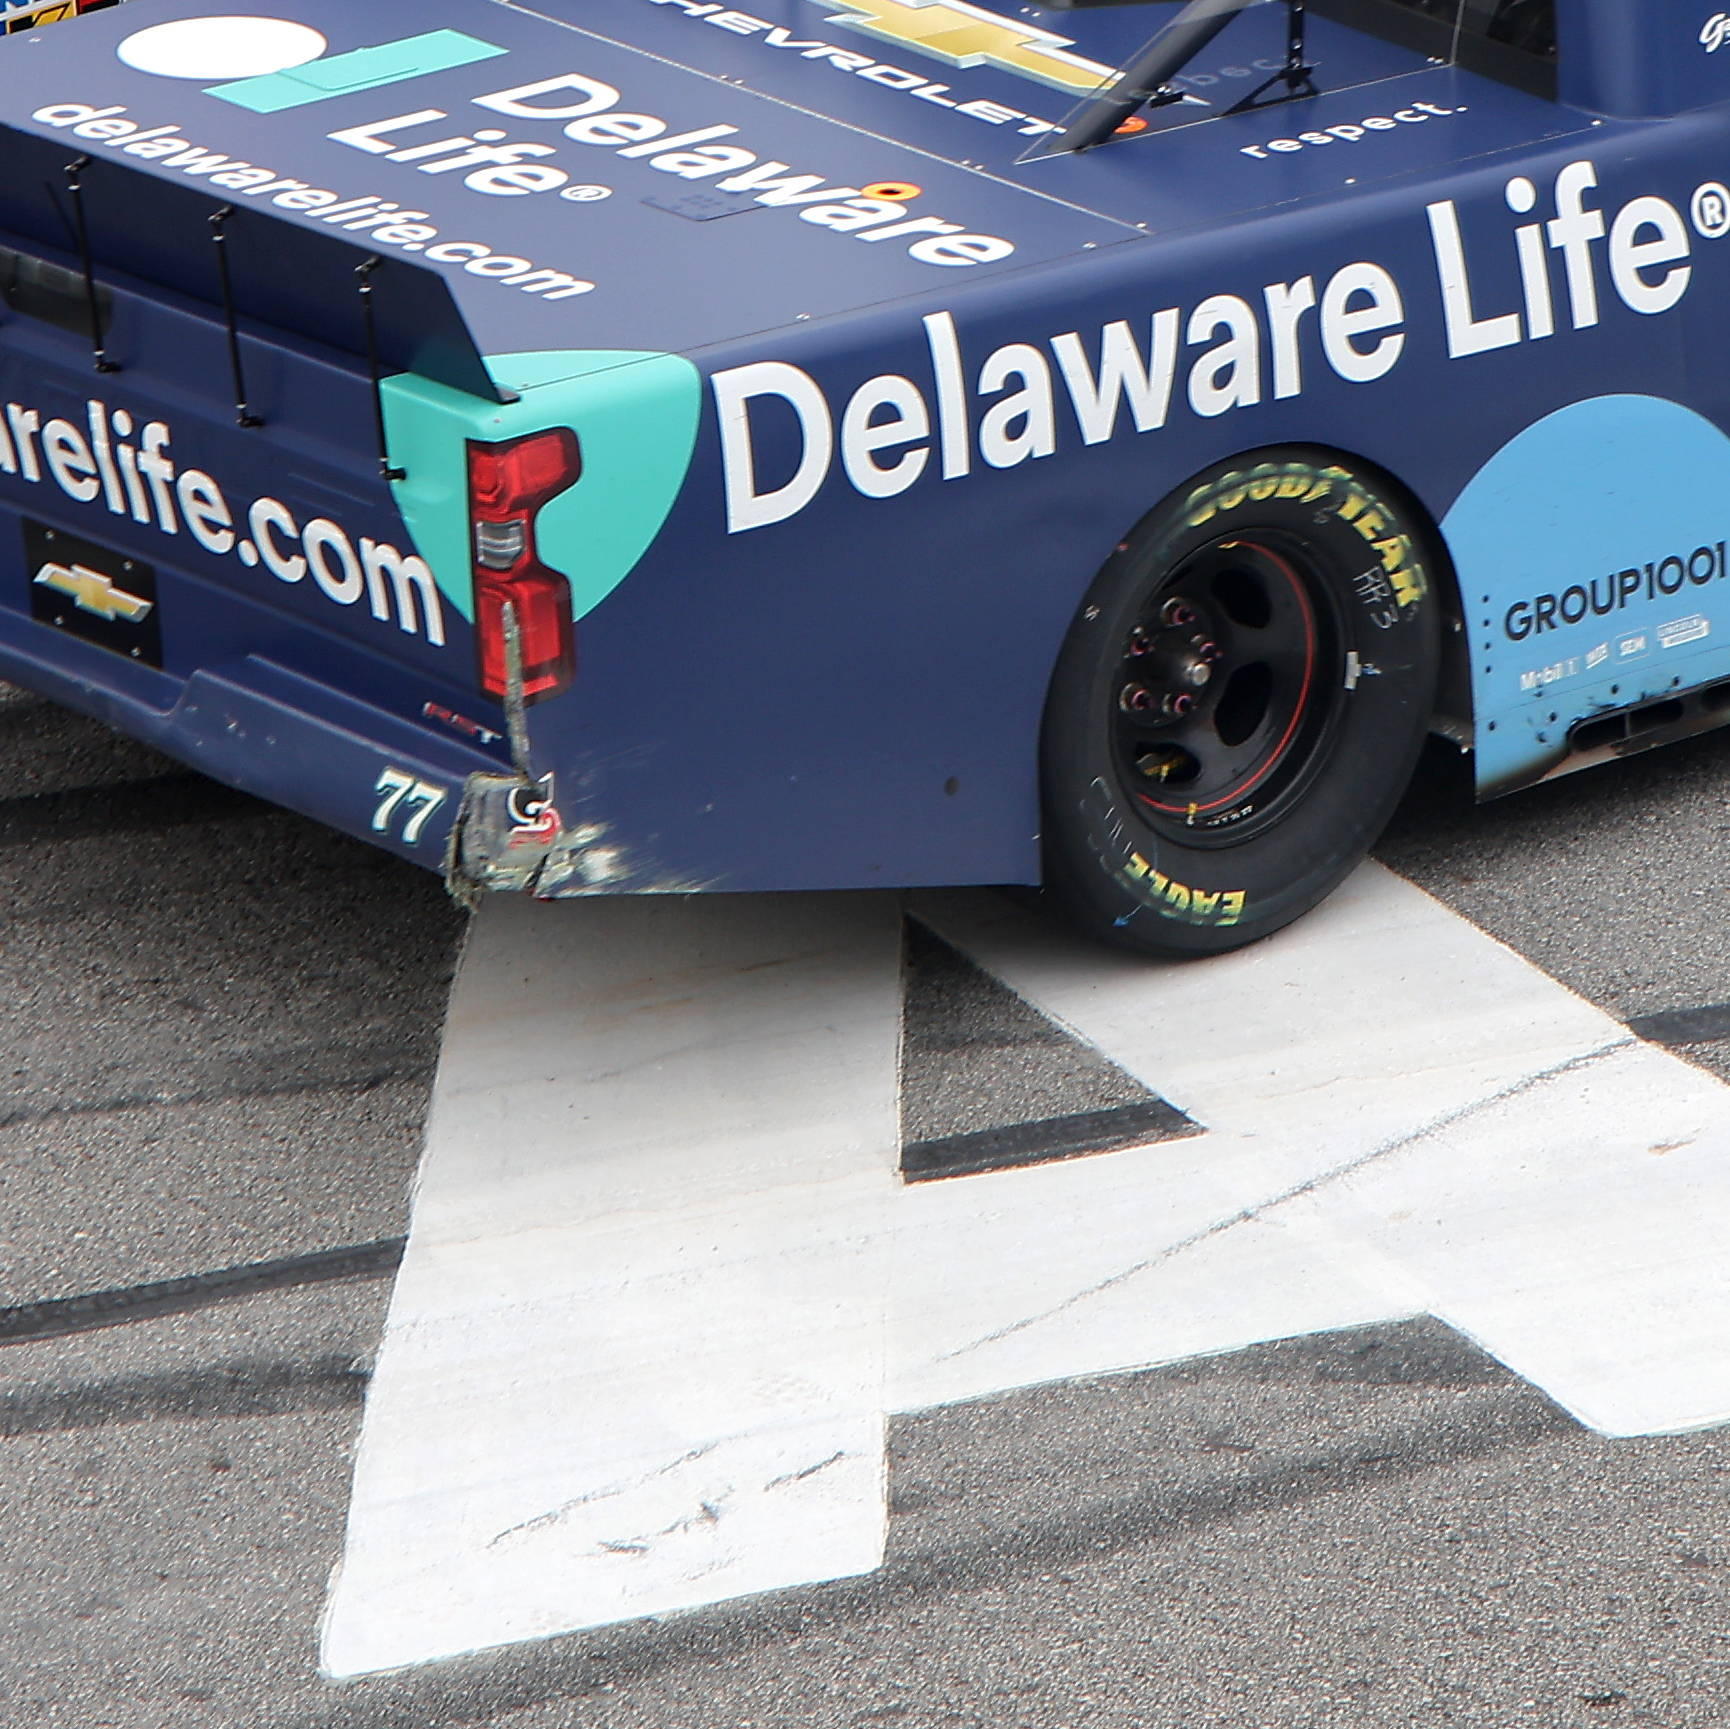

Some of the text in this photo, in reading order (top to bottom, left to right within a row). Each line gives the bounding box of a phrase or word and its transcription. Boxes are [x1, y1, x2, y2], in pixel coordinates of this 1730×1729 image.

[471, 73, 1015, 267] Delaware
[1239, 102, 1468, 159] respect.
[31, 100, 596, 301] delawarelife.com
[711, 260, 1405, 534] Delaware
[1505, 540, 1728, 642] GROUP1001
[372, 765, 449, 847] 77
[1128, 851, 1247, 927] EAGLE
